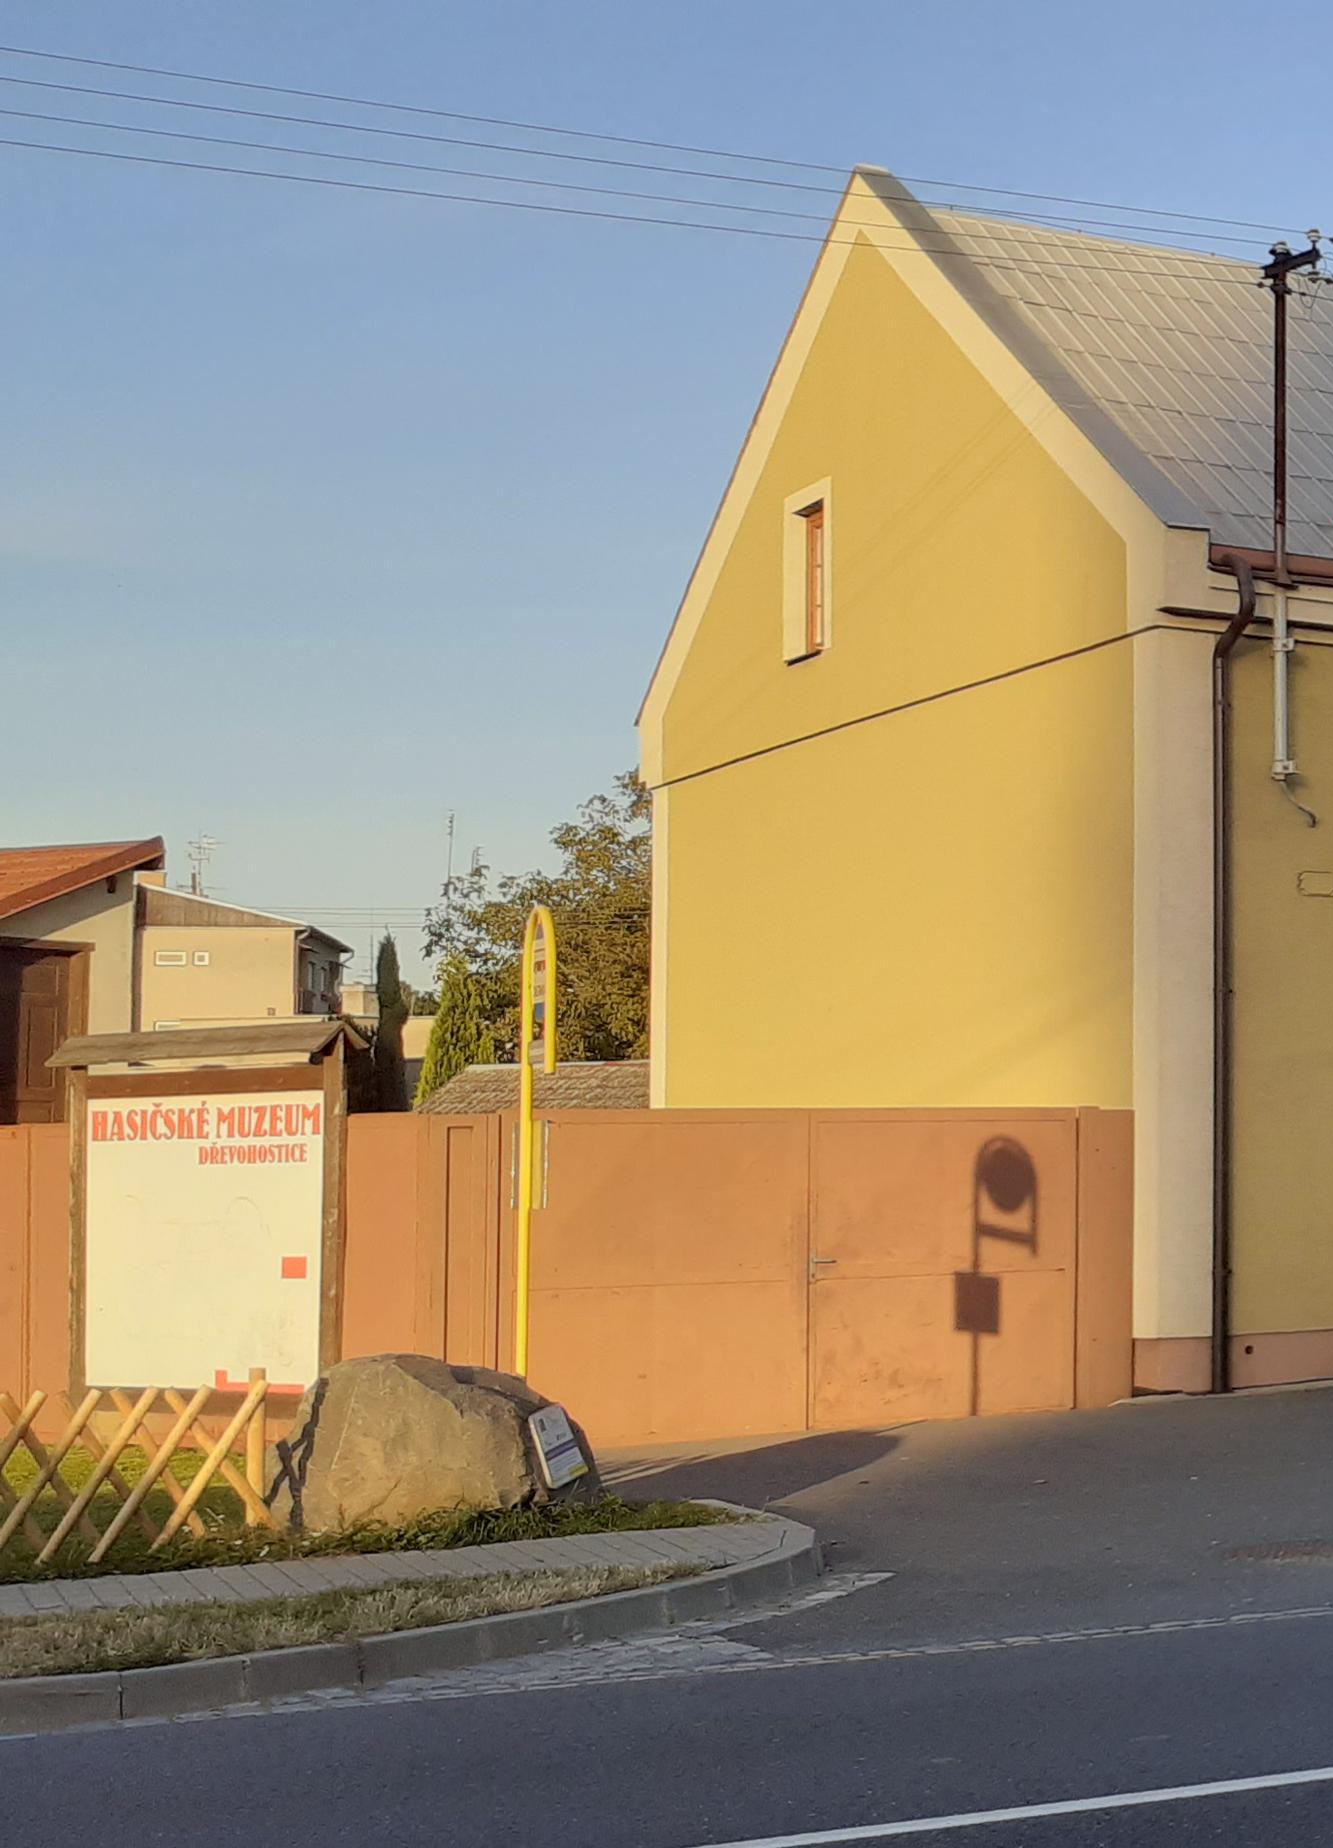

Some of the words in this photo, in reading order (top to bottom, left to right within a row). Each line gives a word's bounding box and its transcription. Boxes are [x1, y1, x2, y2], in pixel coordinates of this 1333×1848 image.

[91, 1100, 210, 1142] HASIČSKÉ
[216, 1103, 321, 1139] MUZEUM
[198, 1142, 308, 1165] DŘEVOHOSTICE
